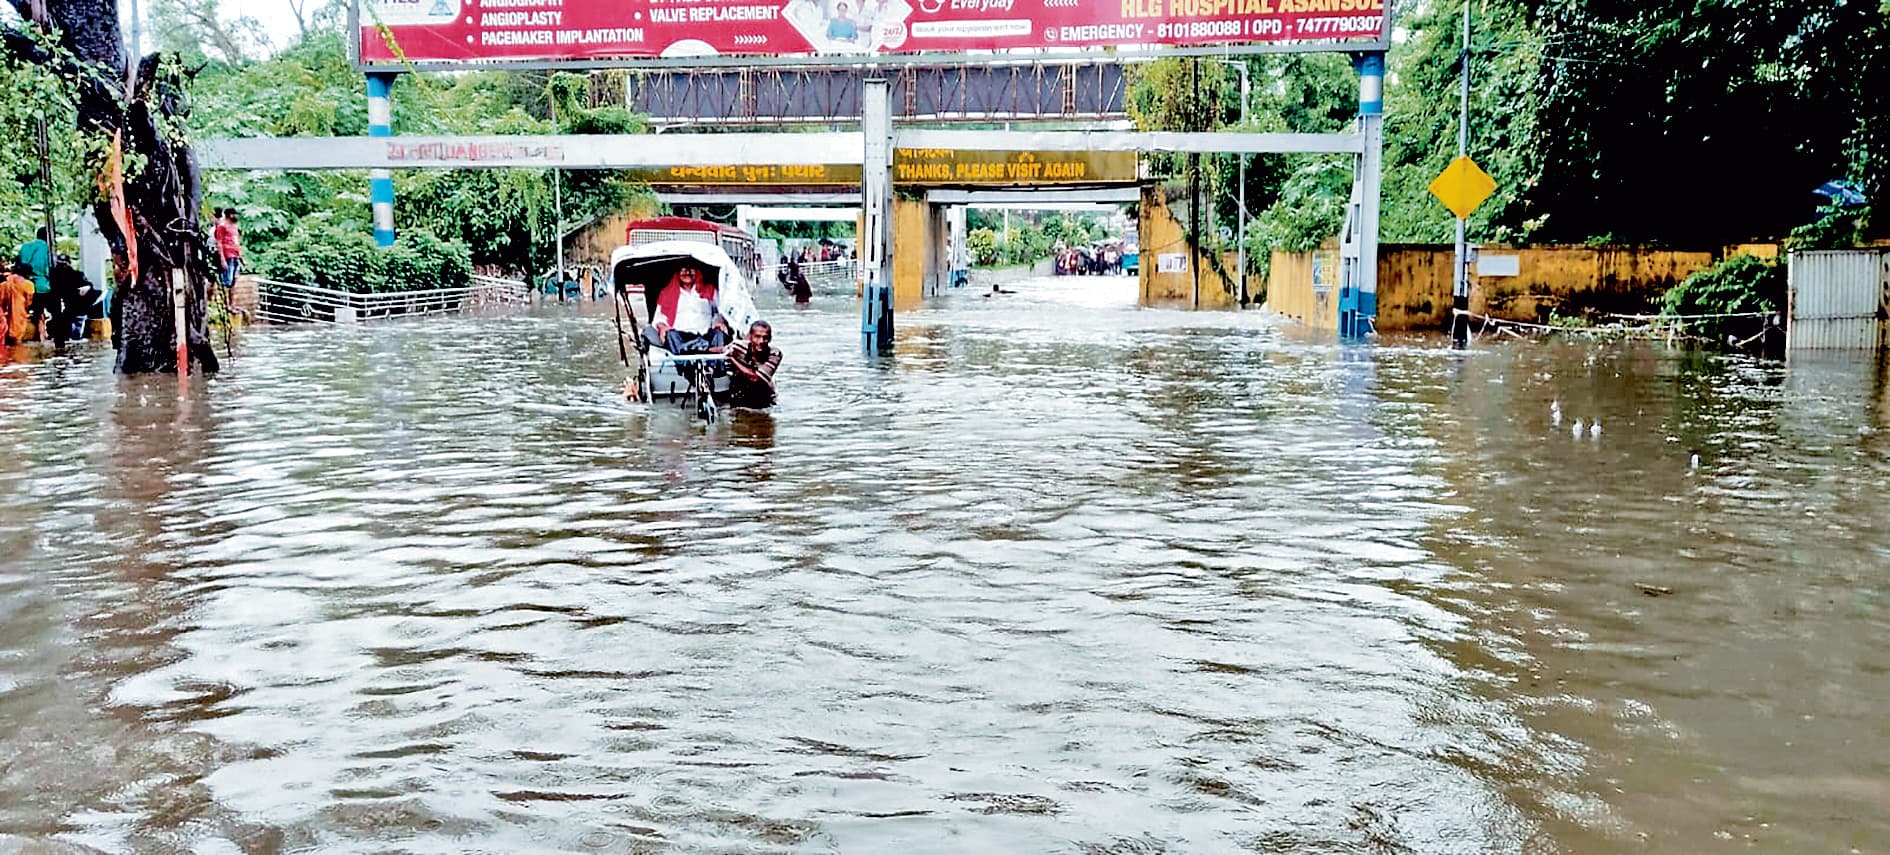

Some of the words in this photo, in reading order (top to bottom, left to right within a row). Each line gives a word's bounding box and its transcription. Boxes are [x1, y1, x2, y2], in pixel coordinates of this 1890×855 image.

[650, 8, 687, 22] VALVE
[690, 5, 780, 21] REPLACEMENT
[1121, 0, 1162, 18] HLG
[481, 11, 562, 26] ANGIOPLASTY
[481, 30, 553, 45] PACEMAKER
[556, 28, 644, 43] IMPLANTATION
[1060, 24, 1143, 41] EMERGENCY
[1158, 20, 1241, 38] 8101880088
[1252, 19, 1282, 35] OPD
[1296, 16, 1383, 33] 7477790307
[898, 163, 952, 180] THANKS,
[956, 163, 1004, 178] PLEASE
[1007, 162, 1041, 178] VISIT
[1044, 162, 1085, 177] AGAIN
